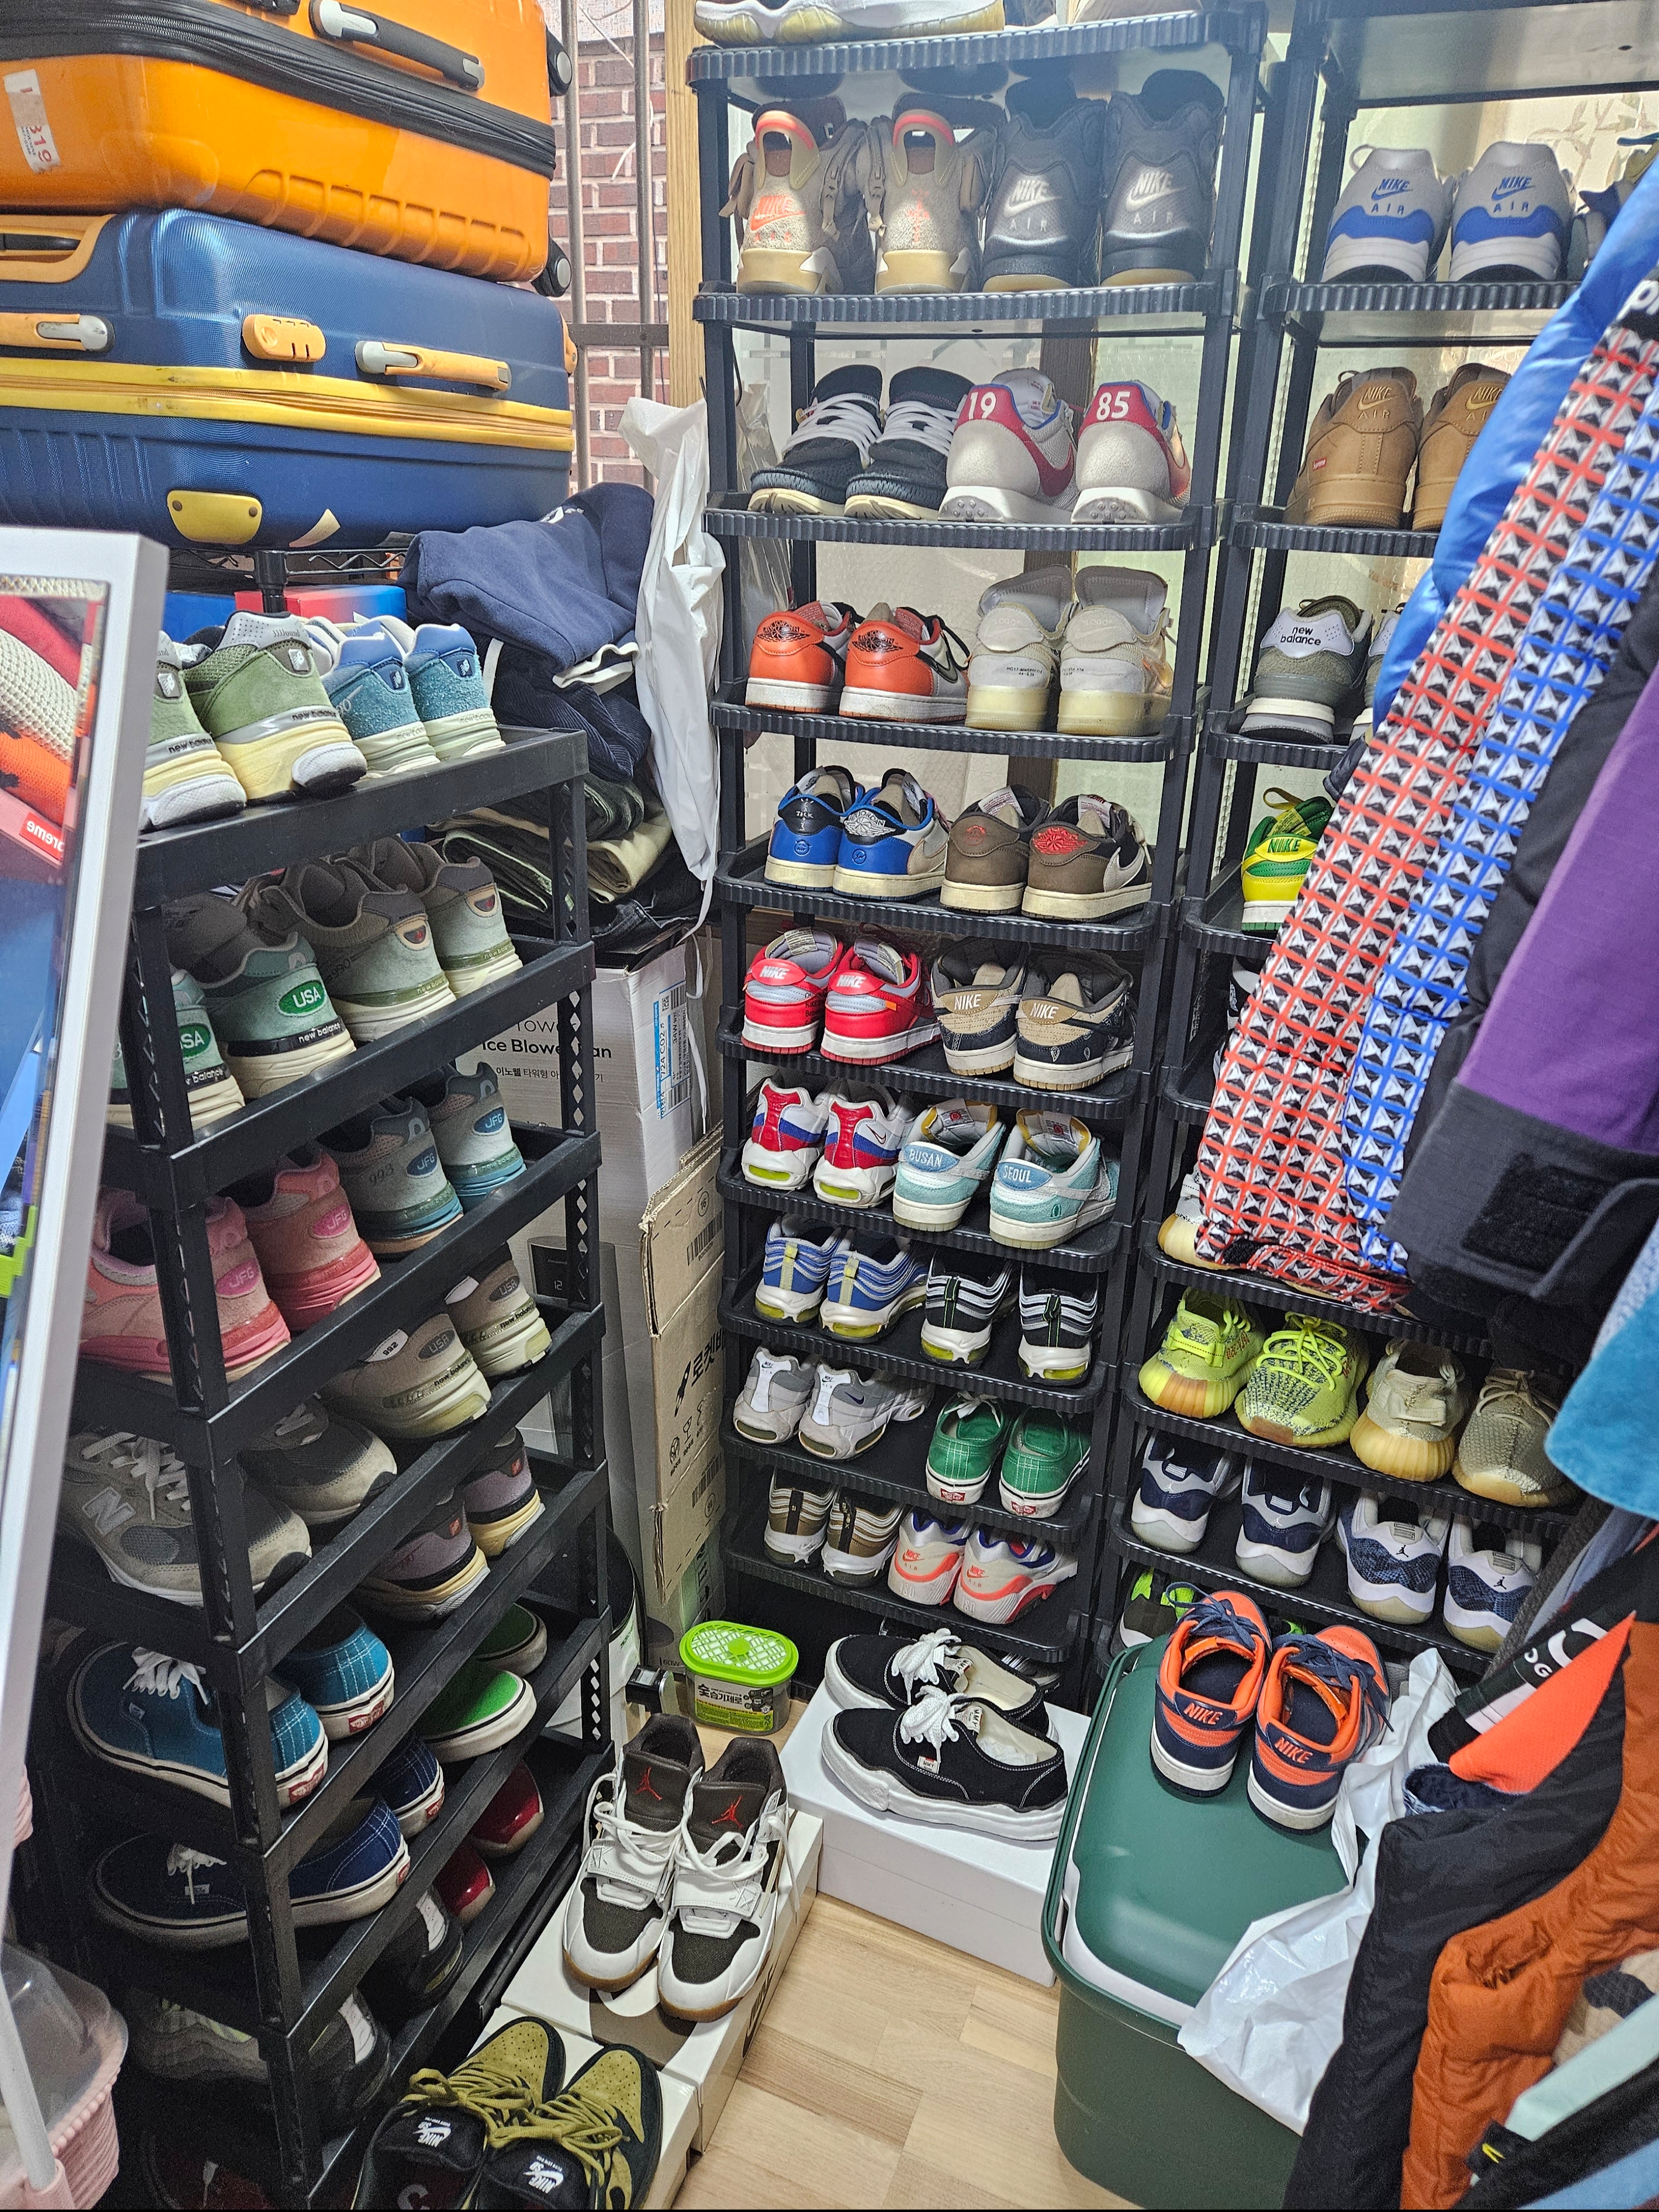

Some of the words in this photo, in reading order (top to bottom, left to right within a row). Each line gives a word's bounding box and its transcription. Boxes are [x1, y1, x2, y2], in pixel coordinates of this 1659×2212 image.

[29, 125, 51, 162] 319
[1133, 171, 1173, 194] NIKE
[1378, 178, 1410, 190] NIKE
[1498, 176, 1532, 190] NIKE
[1010, 180, 1050, 202] NIKE
[1371, 203, 1405, 215] AIR
[1493, 201, 1529, 213] AIR
[1009, 217, 1047, 232] AIR
[1134, 211, 1173, 225] AIR
[1364, 387, 1392, 400] NIKE
[968, 391, 997, 420] 19
[1096, 391, 1130, 421] 85
[1358, 409, 1391, 420] AIR
[1465, 410, 1486, 420] AI
[1292, 626, 1313, 637] new
[1280, 634, 1321, 646] balance
[292, 712, 310, 721] new
[168, 742, 186, 754] new
[857, 810, 886, 827] JORDAN
[1267, 838, 1302, 853] NIKE
[484, 951, 498, 959] new
[759, 965, 790, 979] NIKE
[836, 974, 867, 989] NIKE
[292, 986, 321, 1008] USA
[417, 985, 431, 994] new
[954, 994, 982, 1010] NIKE
[1030, 1003, 1059, 1019] NIKE
[299, 1031, 316, 1044] new
[317, 1022, 341, 1037] balance
[511, 1039, 560, 1055] Blowe
[192, 1068, 224, 1084] balance
[523, 1068, 548, 1078] 타워형
[484, 1113, 503, 1129] JFG
[416, 1152, 435, 1170] JFG
[909, 1148, 943, 1168] BUSAN
[1003, 1165, 1032, 1183] SEOUL
[700, 1197, 707, 1211] 16
[326, 1209, 347, 1230] JFG
[229, 1266, 255, 1288] JFG
[499, 1279, 519, 1295] USA
[554, 1280, 563, 1291] 12
[499, 1316, 515, 1328] new
[383, 1341, 399, 1356] 992
[428, 1333, 450, 1353] USA
[434, 1374, 450, 1387] new
[905, 1549, 921, 1561] NIKE
[904, 1562, 918, 1571] AIR
[969, 1565, 985, 1577] NIKE
[968, 1579, 982, 1588] AIR
[1183, 1702, 1223, 1725] NIKE
[1274, 1736, 1313, 1764] NIKE
[418, 2121, 431, 2130] SB
[418, 2131, 443, 2148] NIKE
[529, 2161, 545, 2172] SB
[528, 2176, 556, 2194] NIKE
